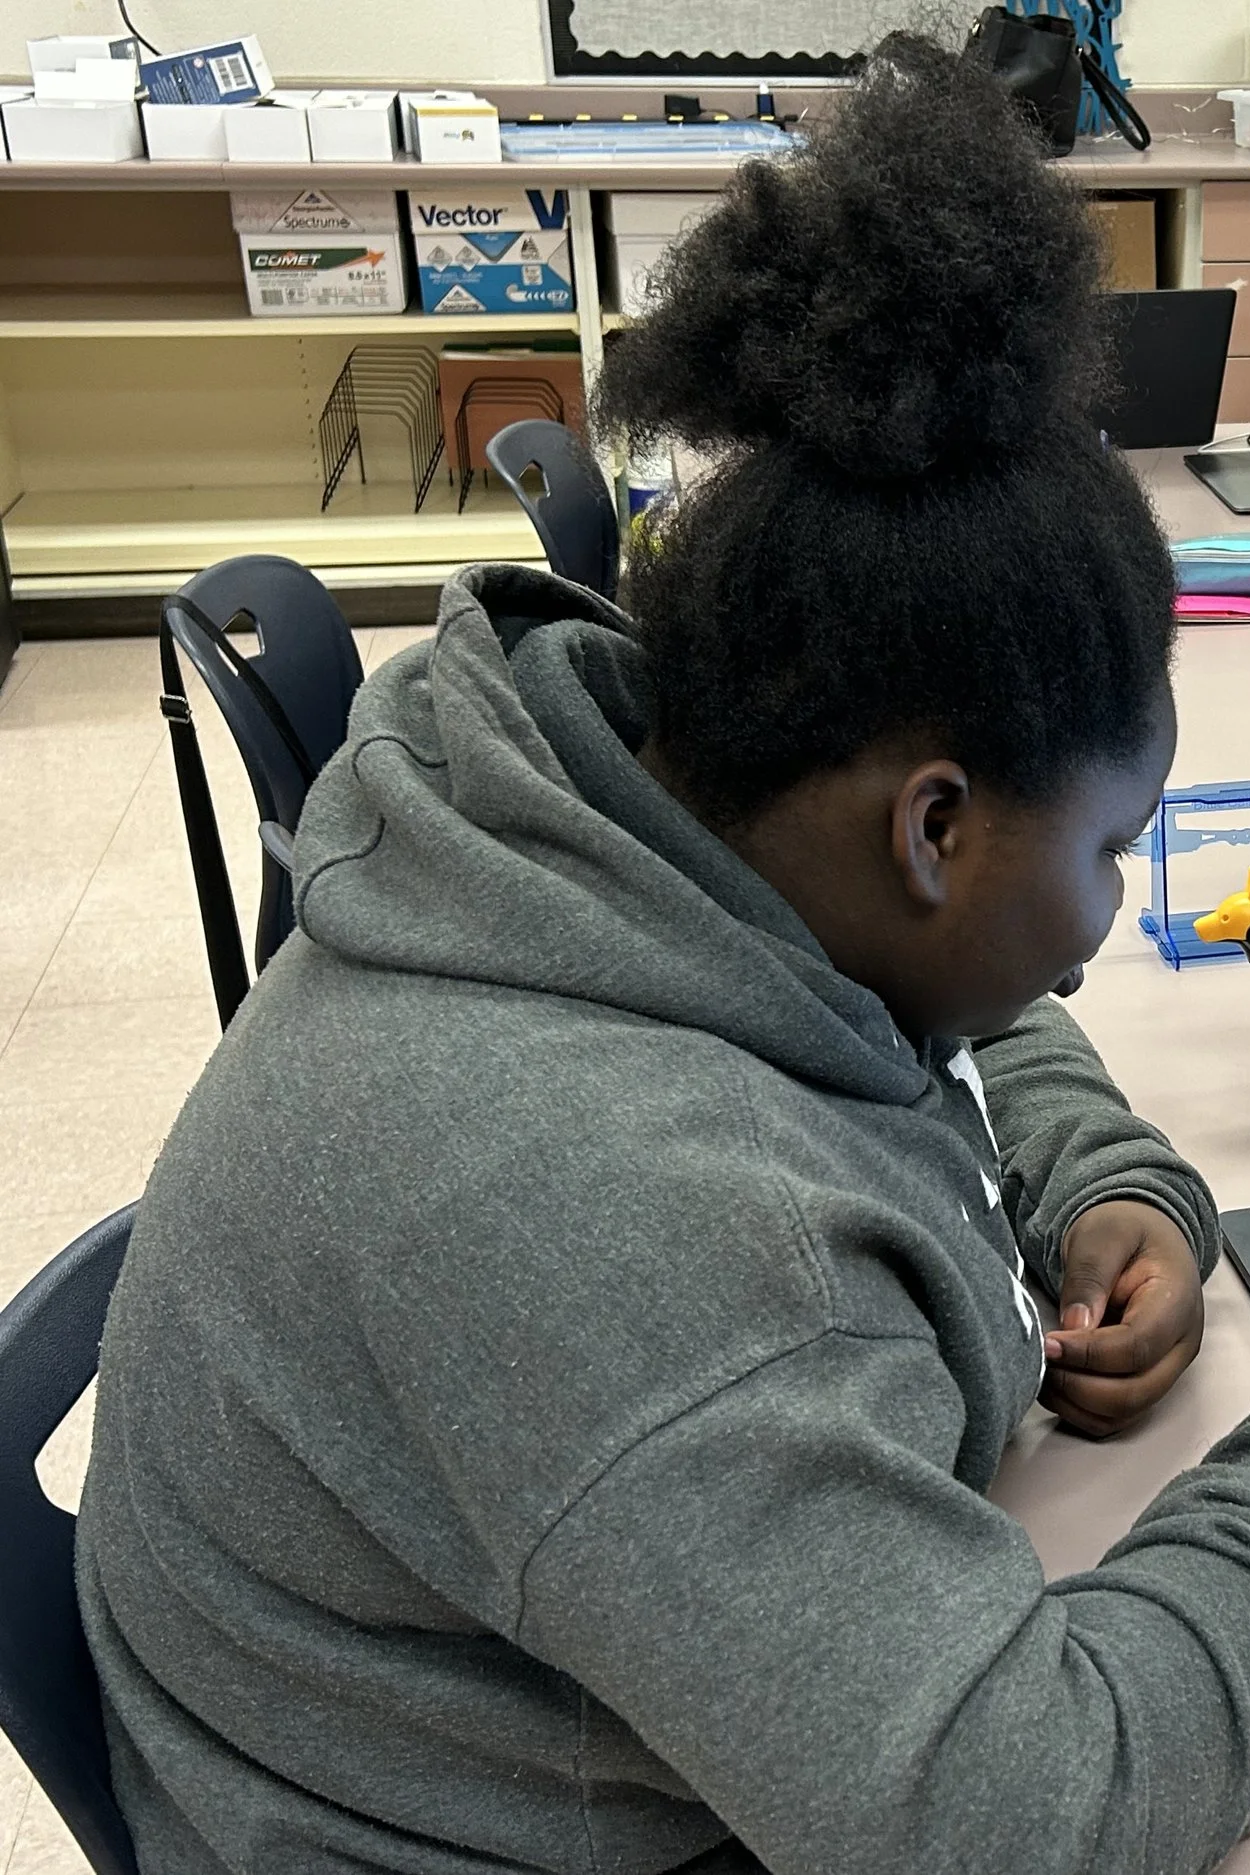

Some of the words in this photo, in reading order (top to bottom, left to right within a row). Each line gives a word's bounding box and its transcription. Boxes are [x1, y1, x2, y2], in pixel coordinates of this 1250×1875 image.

[283, 214, 340, 229] Spectrum
[417, 204, 504, 228] Vector
[254, 253, 322, 267] COMET
